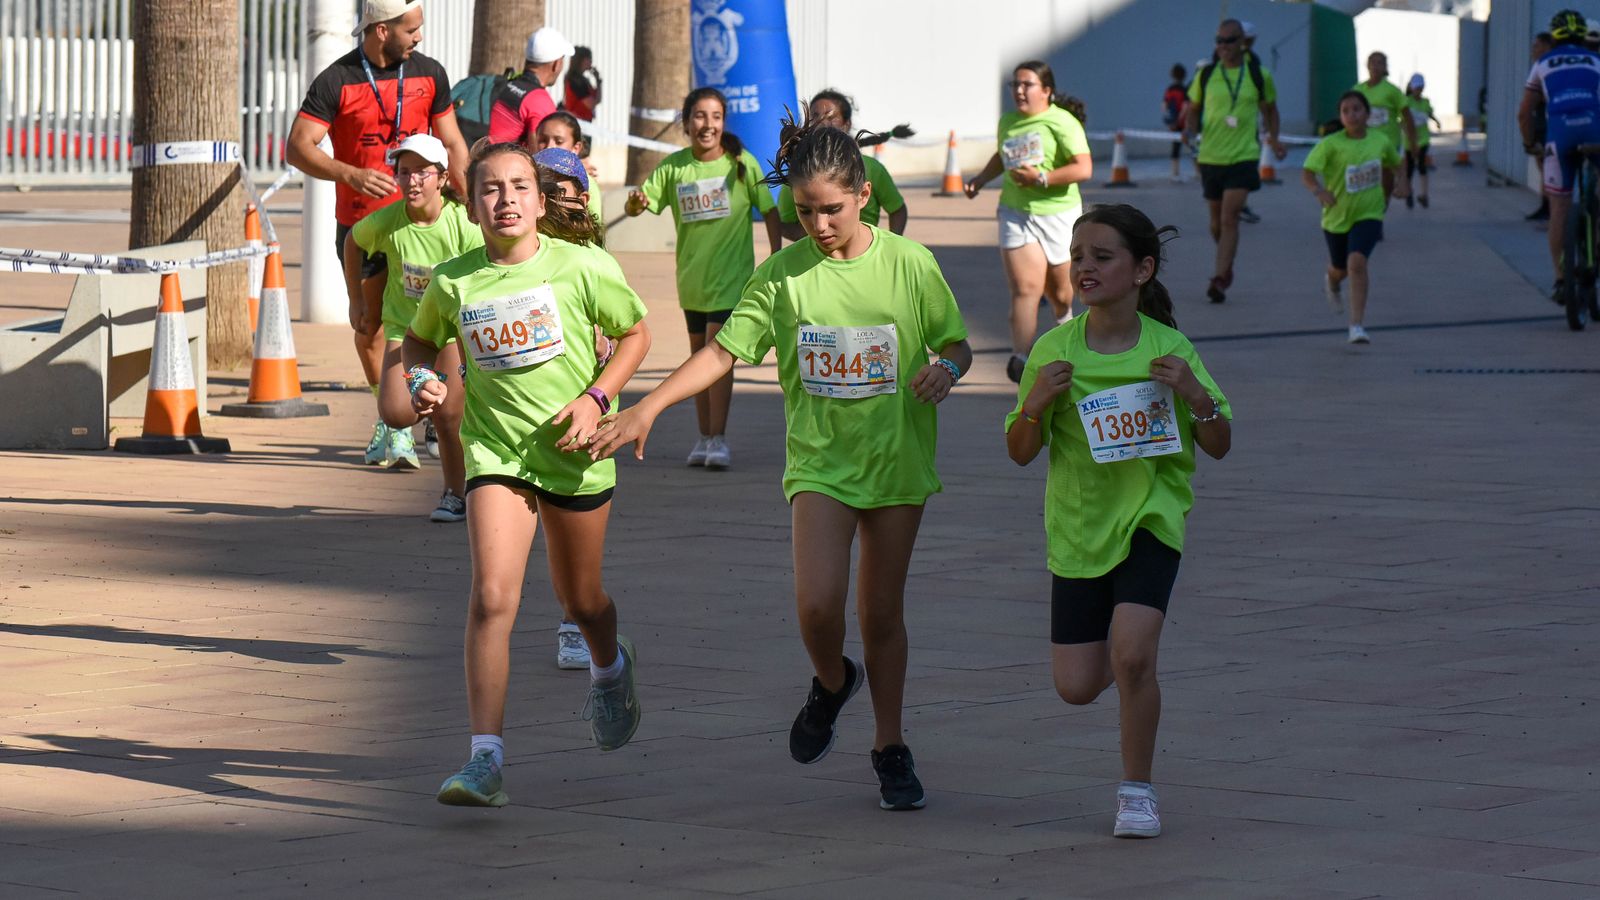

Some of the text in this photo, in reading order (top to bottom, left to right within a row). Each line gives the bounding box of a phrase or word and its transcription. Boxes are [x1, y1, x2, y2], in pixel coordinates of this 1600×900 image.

[1549, 55, 1595, 69] UCA
[681, 194, 710, 212] 1310
[462, 310, 478, 323] XXI
[471, 320, 528, 353] 1349
[801, 331, 818, 343] XXI
[805, 351, 864, 379] 1344
[1081, 398, 1100, 413] XXI
[1091, 410, 1148, 442] 1389
